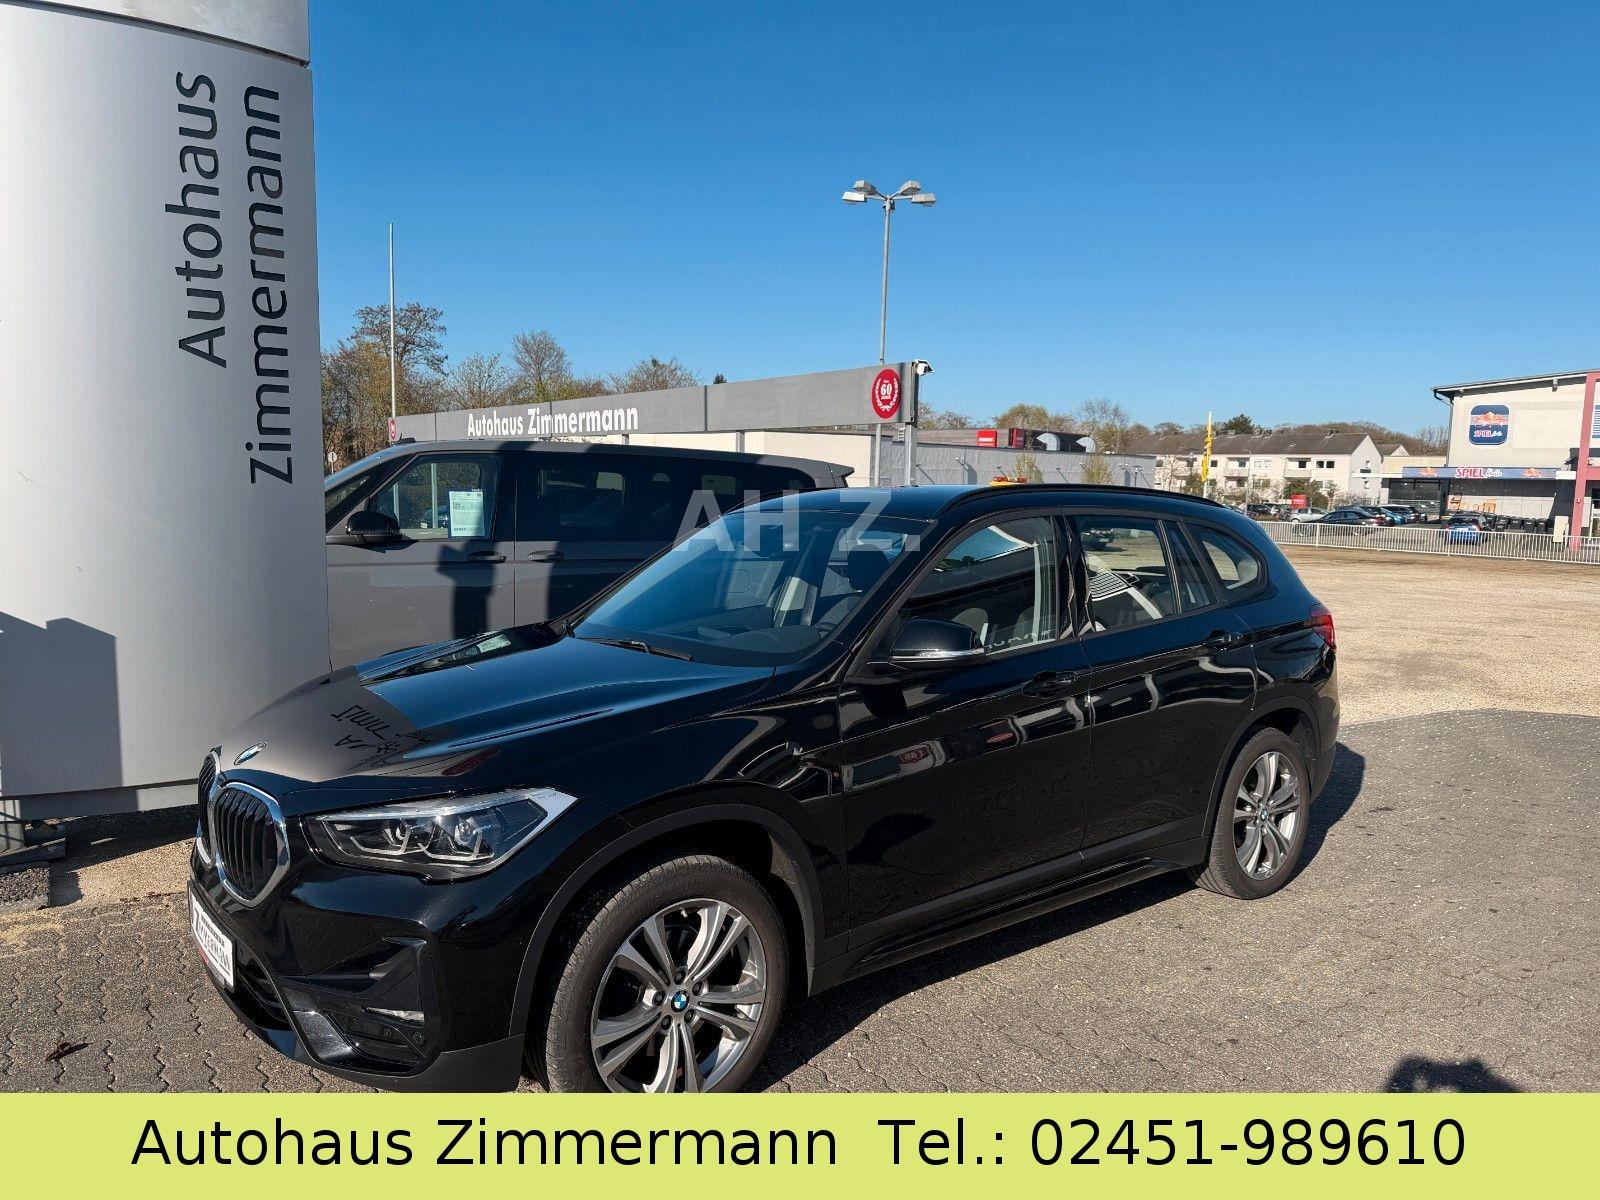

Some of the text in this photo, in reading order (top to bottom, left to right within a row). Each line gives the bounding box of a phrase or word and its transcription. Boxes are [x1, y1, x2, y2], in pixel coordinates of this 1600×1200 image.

[165, 71, 228, 369] Autohaus
[244, 85, 293, 485] Zimmermann
[880, 383, 893, 396] 60
[467, 406, 639, 437] Autohaus Zimmermann
[1455, 467, 1486, 479] SPIEL
